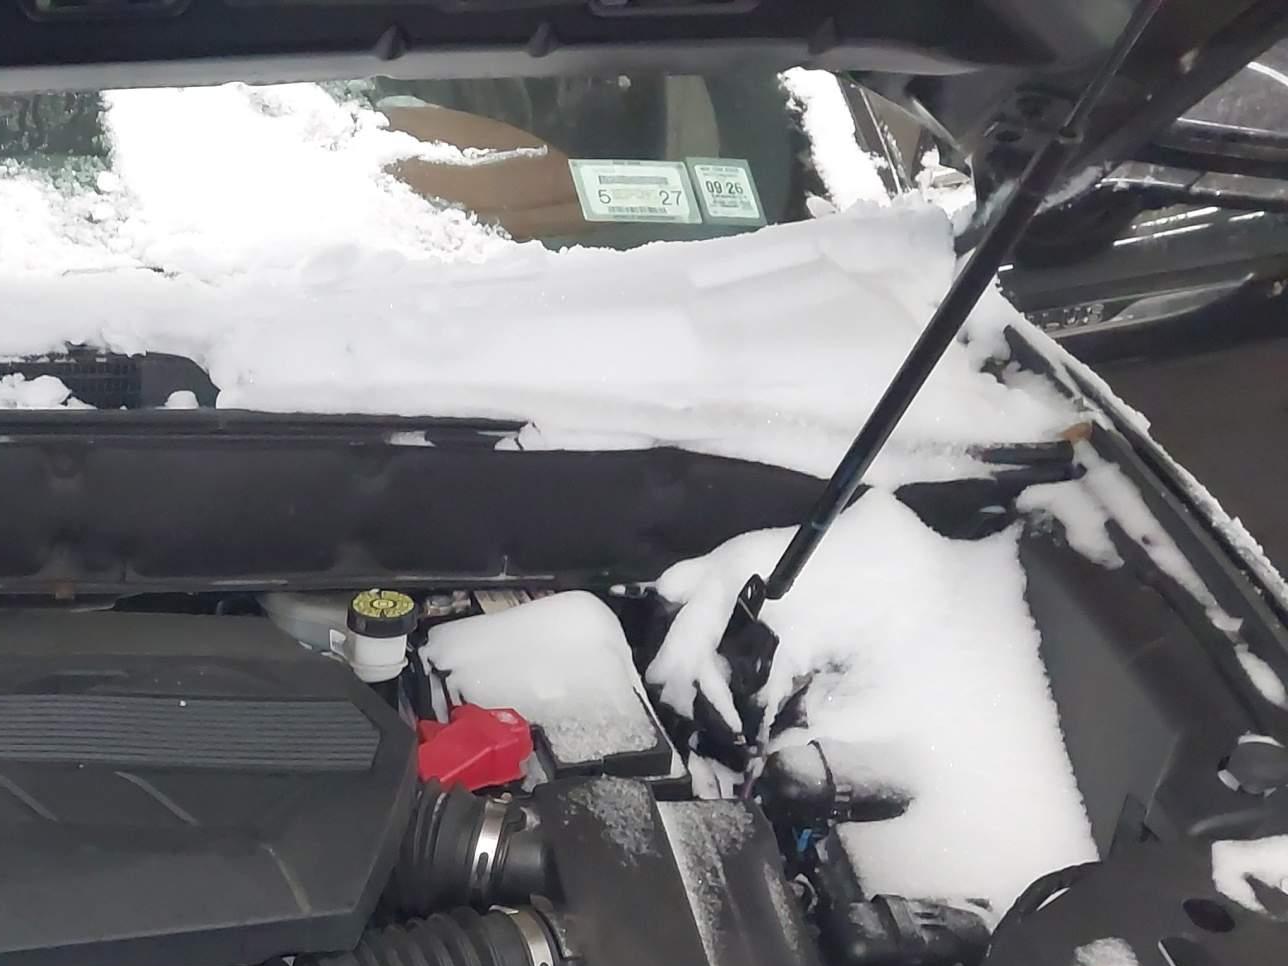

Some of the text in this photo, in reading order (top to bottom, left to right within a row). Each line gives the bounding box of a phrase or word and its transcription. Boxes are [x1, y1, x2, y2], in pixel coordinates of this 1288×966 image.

[705, 180, 743, 194] 09 26
[598, 189, 682, 206] 5 27
